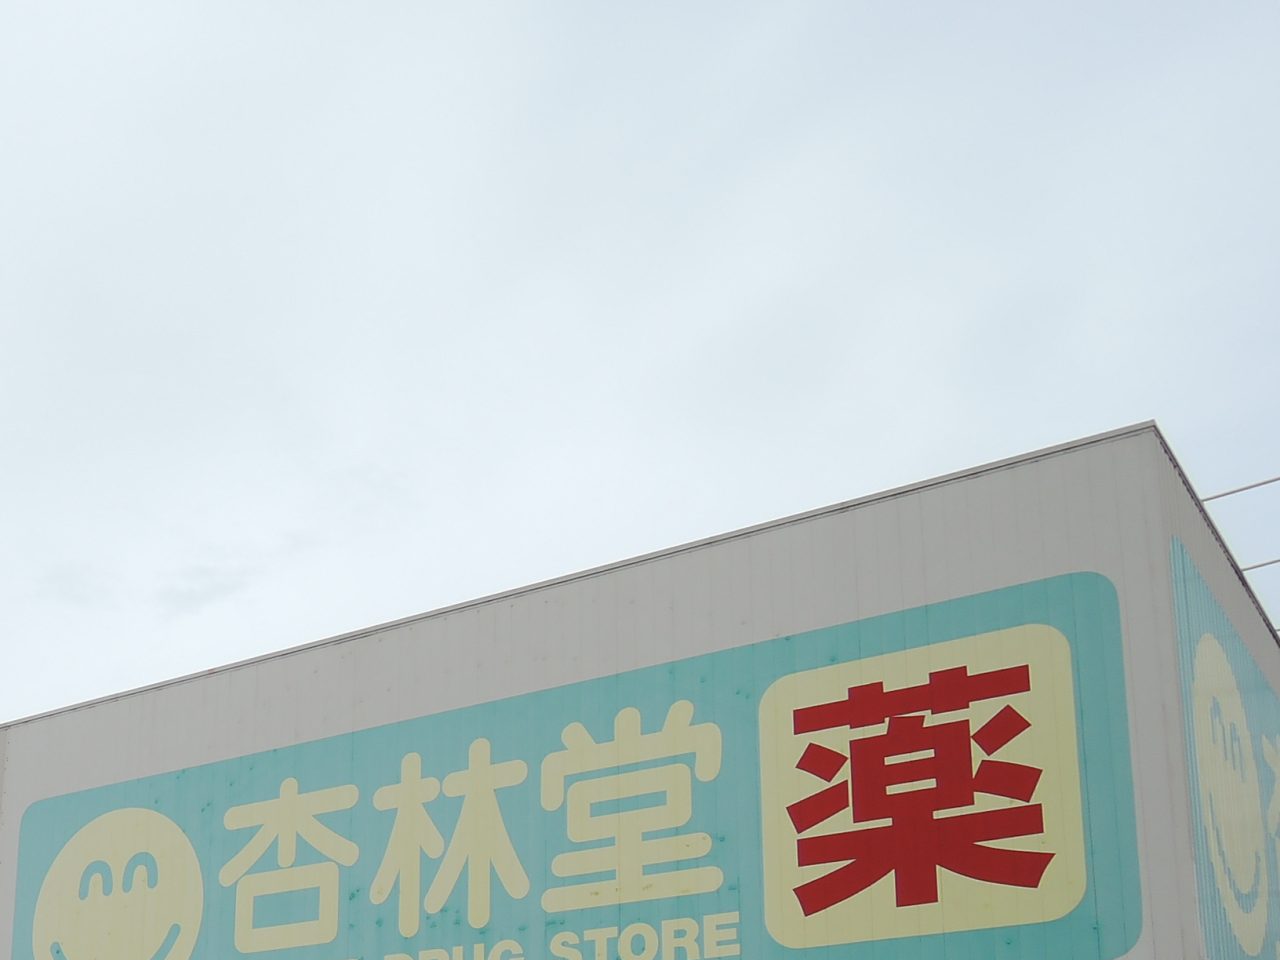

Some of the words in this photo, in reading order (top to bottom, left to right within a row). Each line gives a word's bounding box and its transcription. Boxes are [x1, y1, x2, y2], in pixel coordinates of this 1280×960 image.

[219, 700, 723, 954] 杏林堂
[786, 664, 1057, 917] 薬
